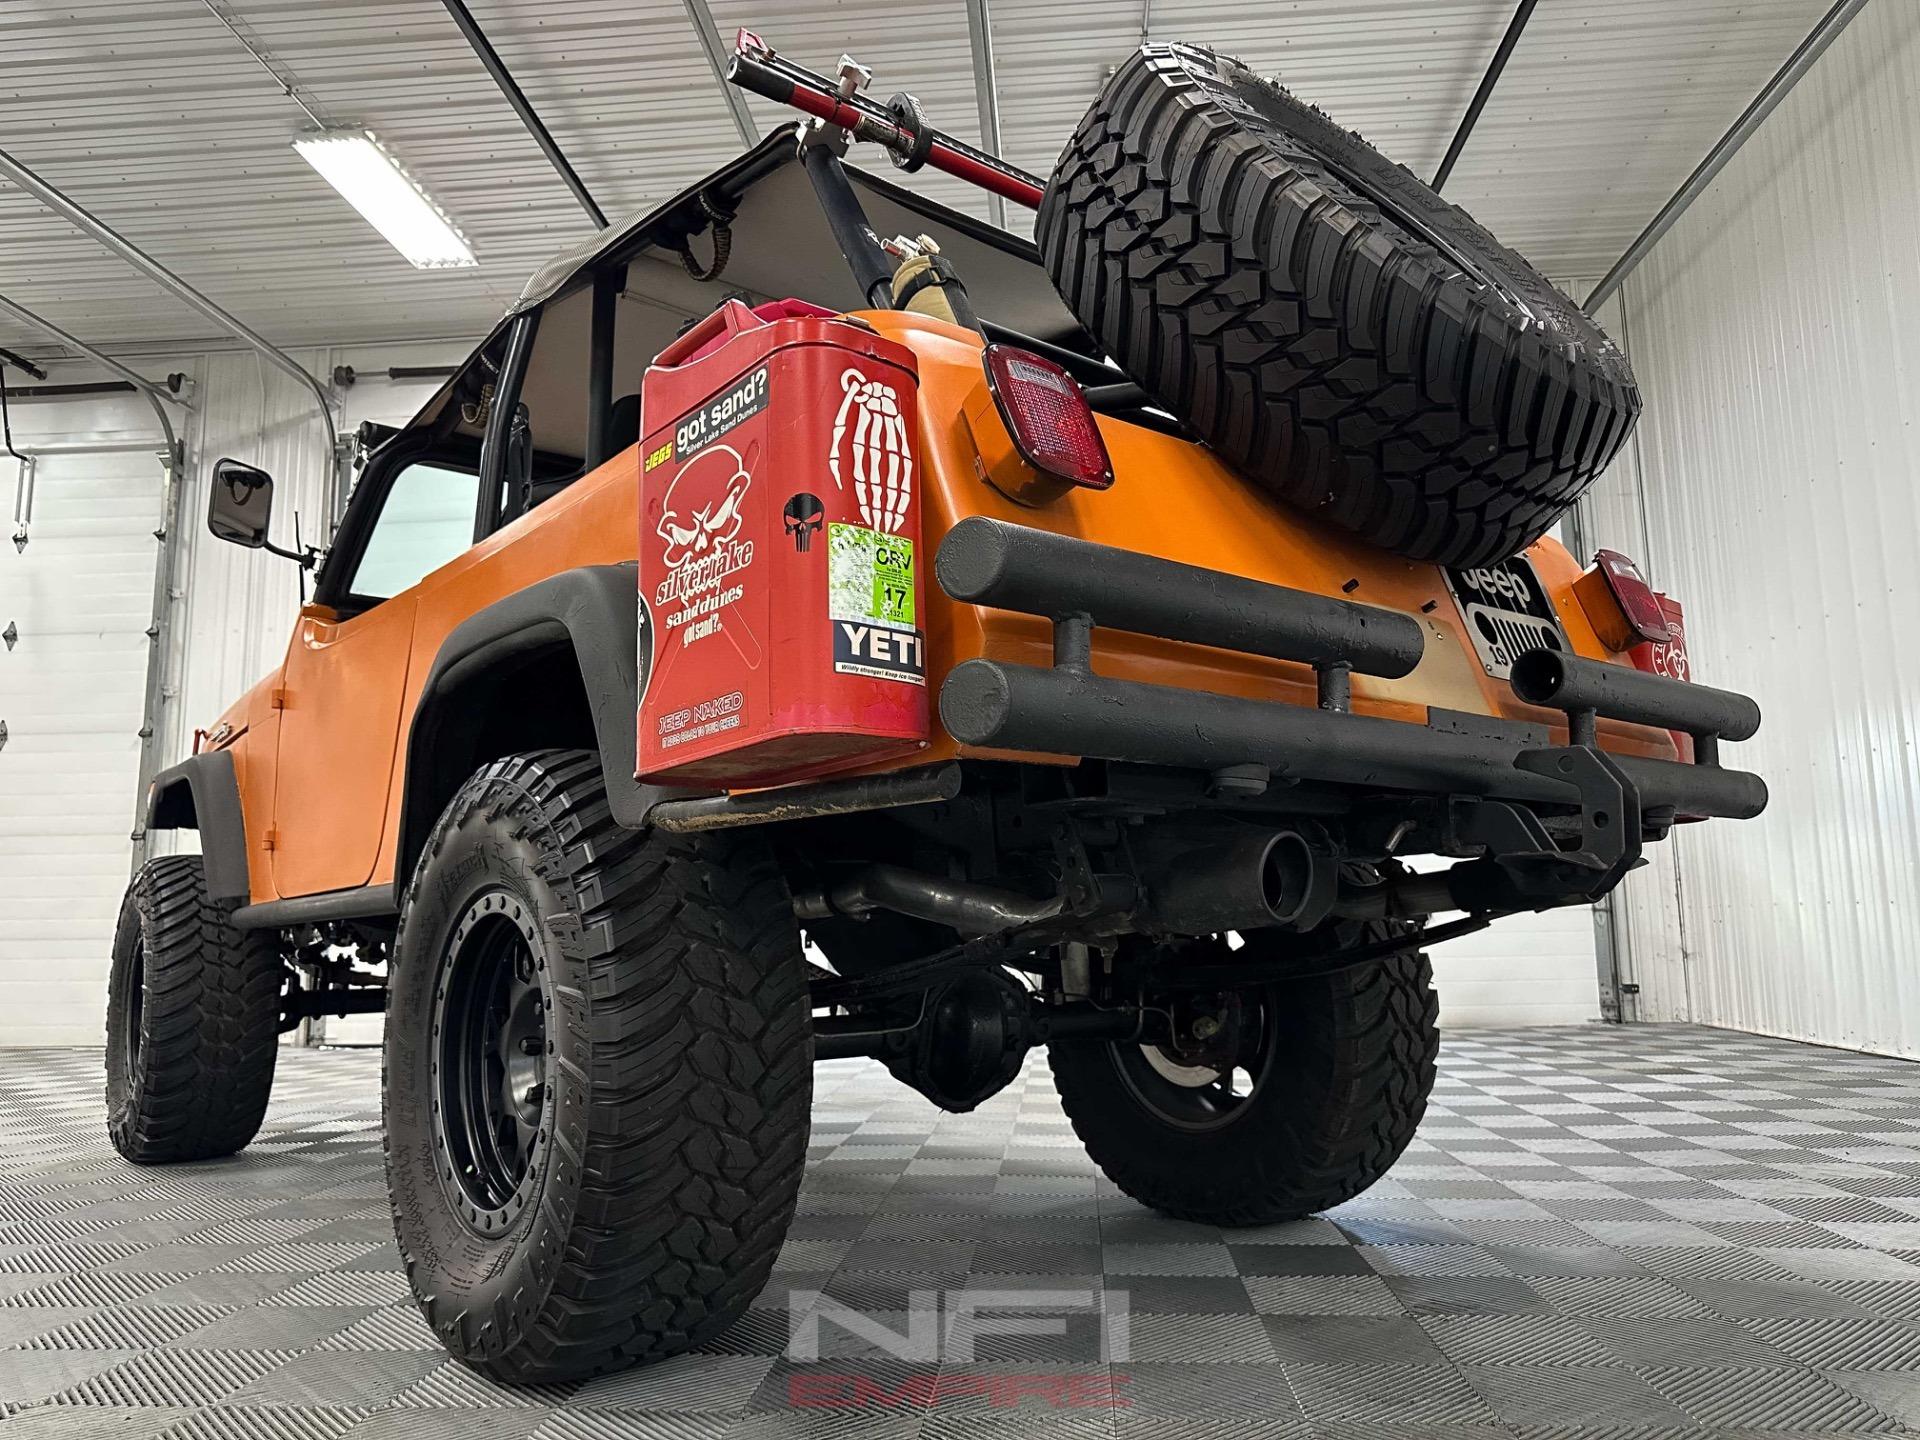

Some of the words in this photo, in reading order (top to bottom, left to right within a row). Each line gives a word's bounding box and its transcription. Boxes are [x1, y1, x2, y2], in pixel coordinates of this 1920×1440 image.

[677, 410, 707, 453] got
[711, 368, 767, 427] sand?
[686, 438, 704, 455] Silver
[704, 430, 719, 444] Lake
[720, 416, 737, 434] Sand
[737, 404, 758, 423] Dunes
[645, 440, 673, 473] JEGS
[884, 587, 906, 609] 17
[1462, 567, 1531, 609] Jeep
[840, 623, 922, 668] YETI
[658, 709, 692, 735] JEEP
[694, 691, 744, 724] NAKED
